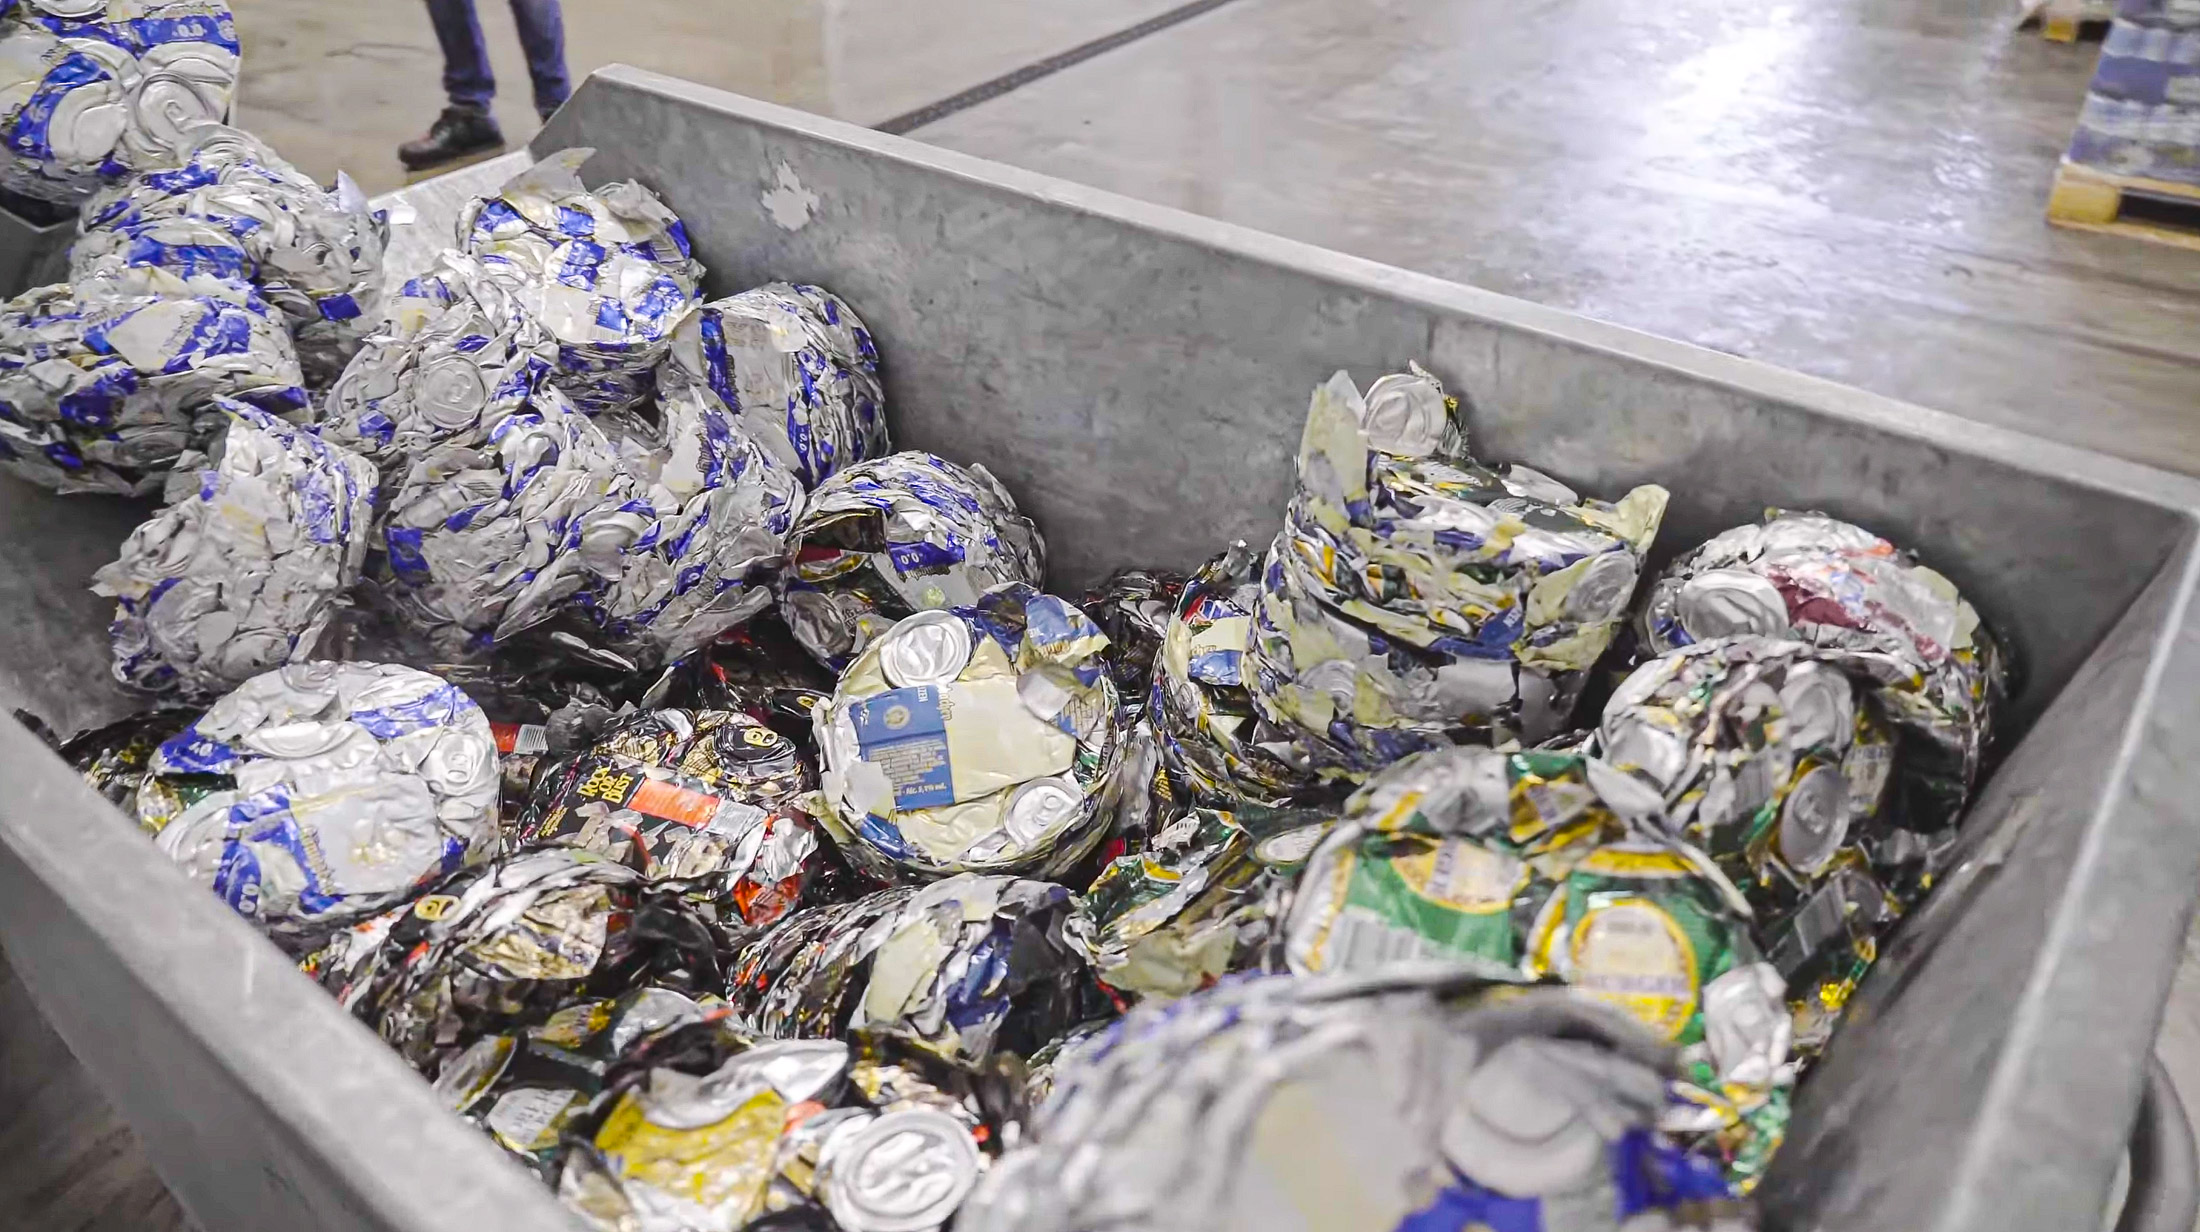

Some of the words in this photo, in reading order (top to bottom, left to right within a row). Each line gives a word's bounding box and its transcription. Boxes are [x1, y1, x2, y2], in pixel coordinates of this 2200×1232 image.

[177, 23, 204, 38] 0.0
[799, 433, 808, 452] 0.0
[900, 552, 920, 566] 0.0
[598, 775, 619, 792] OR
[601, 772, 634, 804] BUST
[238, 883, 260, 914] 0.0
